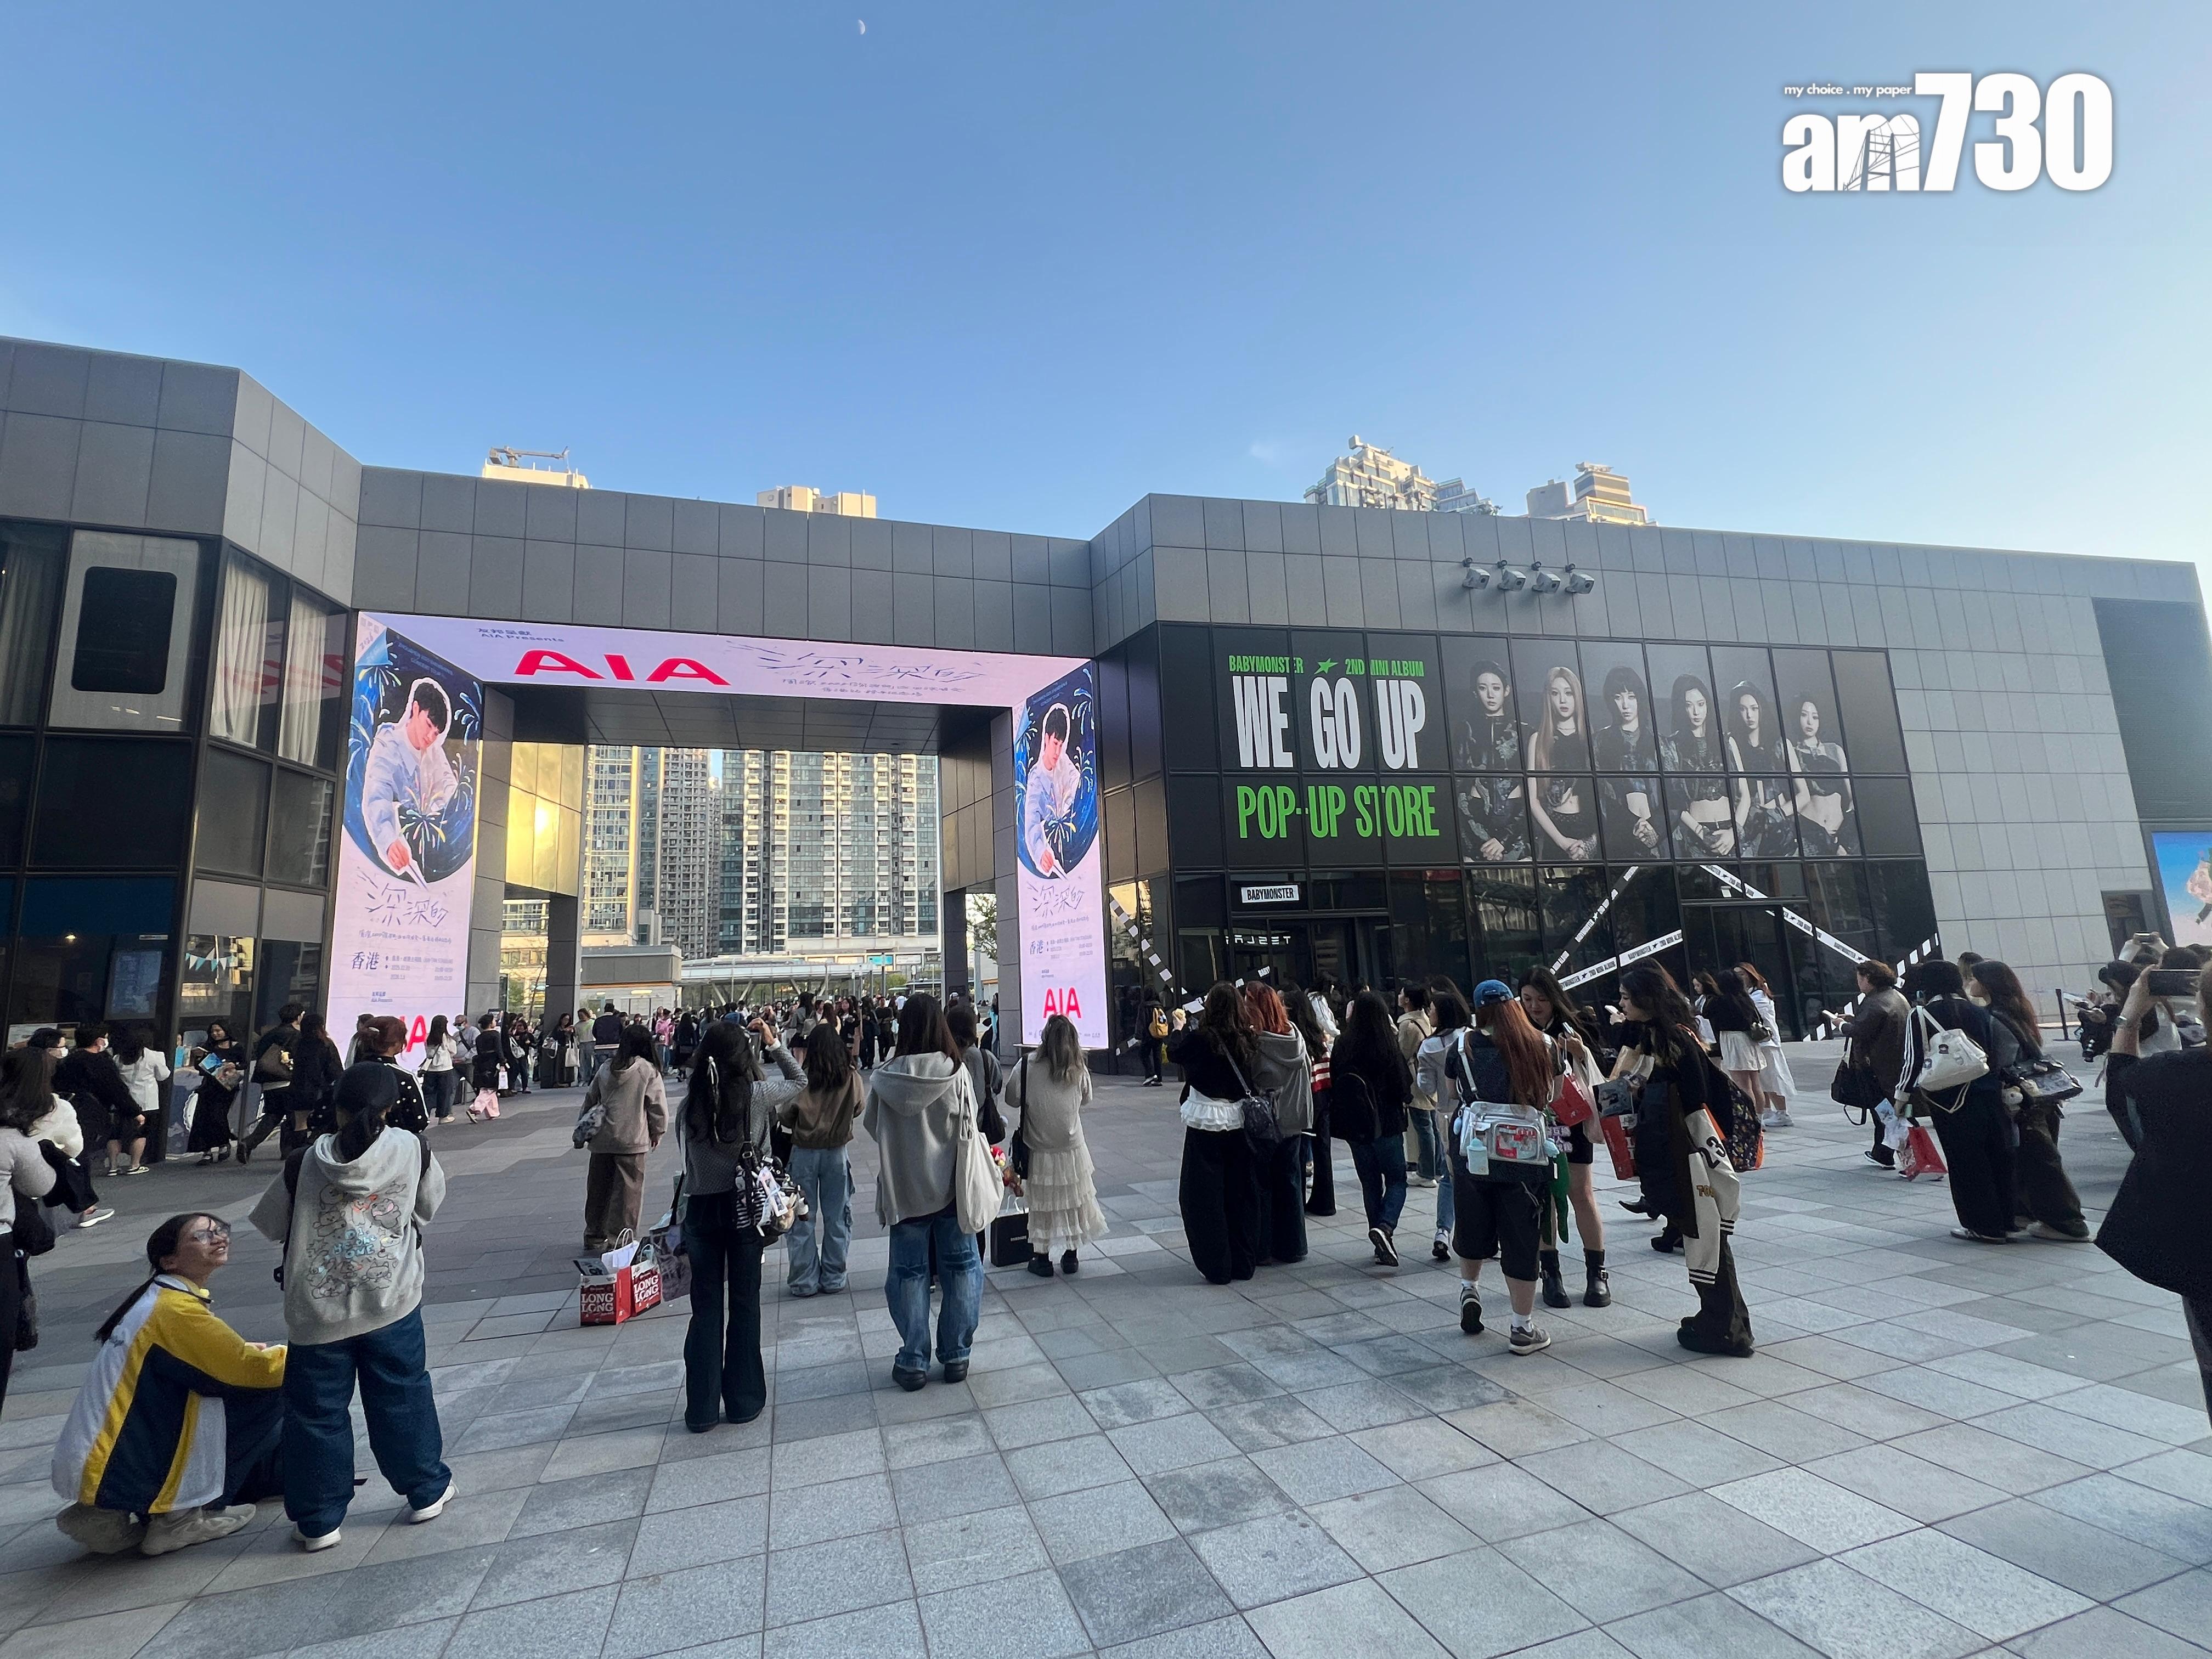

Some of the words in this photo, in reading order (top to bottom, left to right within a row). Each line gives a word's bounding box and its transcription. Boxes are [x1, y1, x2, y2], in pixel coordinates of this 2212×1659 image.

[515, 650, 730, 686] AIA
[1345, 659, 1365, 675] 2ND
[1391, 660, 1425, 677] ALBUM
[1232, 675, 1294, 768] WE
[1310, 676, 1361, 769] GO
[1376, 679, 1426, 769] UP
[1237, 785, 1346, 839] POP-UP
[1353, 785, 1440, 838] STORE
[1246, 887, 1295, 901] BABYMONSTER
[1029, 939, 1044, 956] 香港
[351, 951, 380, 970] 香港
[1043, 988, 1081, 1019] AIA
[1699, 1136, 1726, 1169] 23
[633, 1275, 659, 1294] LONG
[634, 1284, 660, 1304] LONG
[581, 1293, 614, 1303] LONG
[581, 1303, 614, 1313] LONG
